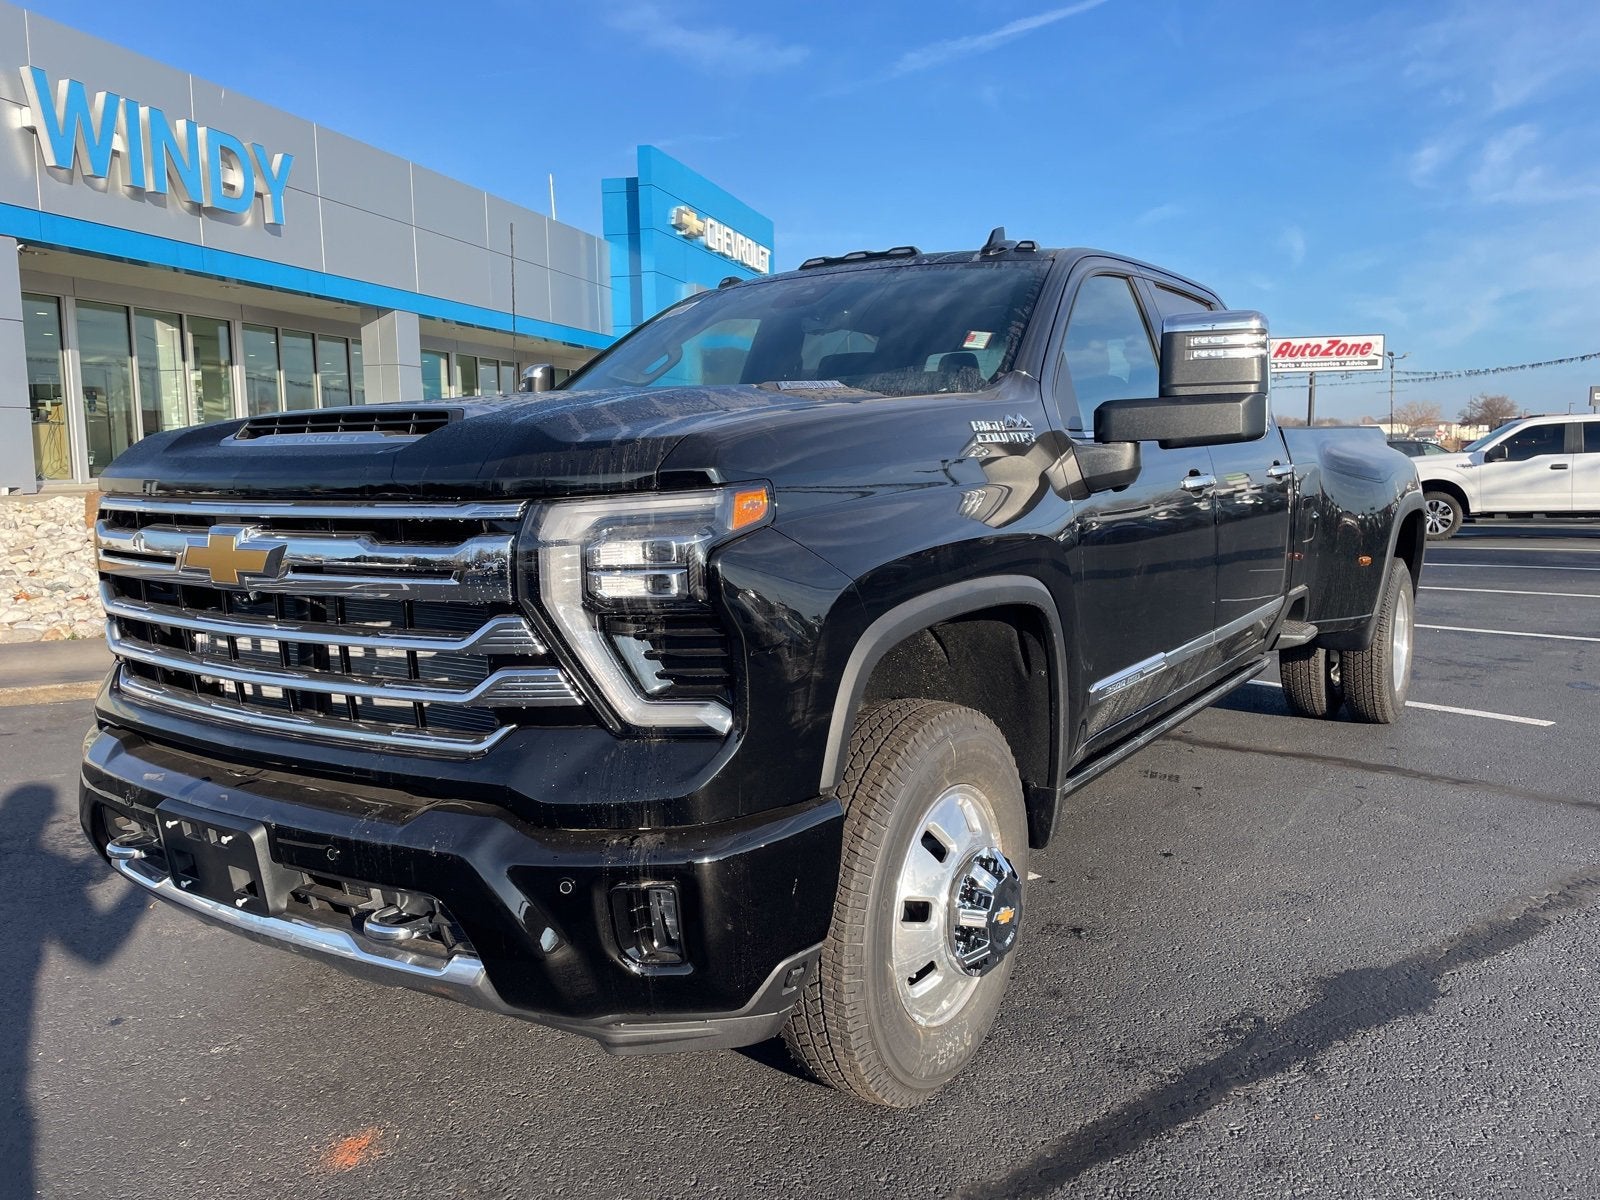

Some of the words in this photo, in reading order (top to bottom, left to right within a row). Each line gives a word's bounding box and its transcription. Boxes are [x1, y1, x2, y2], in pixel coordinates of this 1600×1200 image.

[20, 66, 294, 226] WINDY
[704, 217, 771, 274] CHEVROLET
[1273, 339, 1373, 358] AutoZone
[970, 420, 1005, 431] HIGH
[264, 434, 365, 444] CHEVROLET
[976, 432, 1036, 443] COUNTRY
